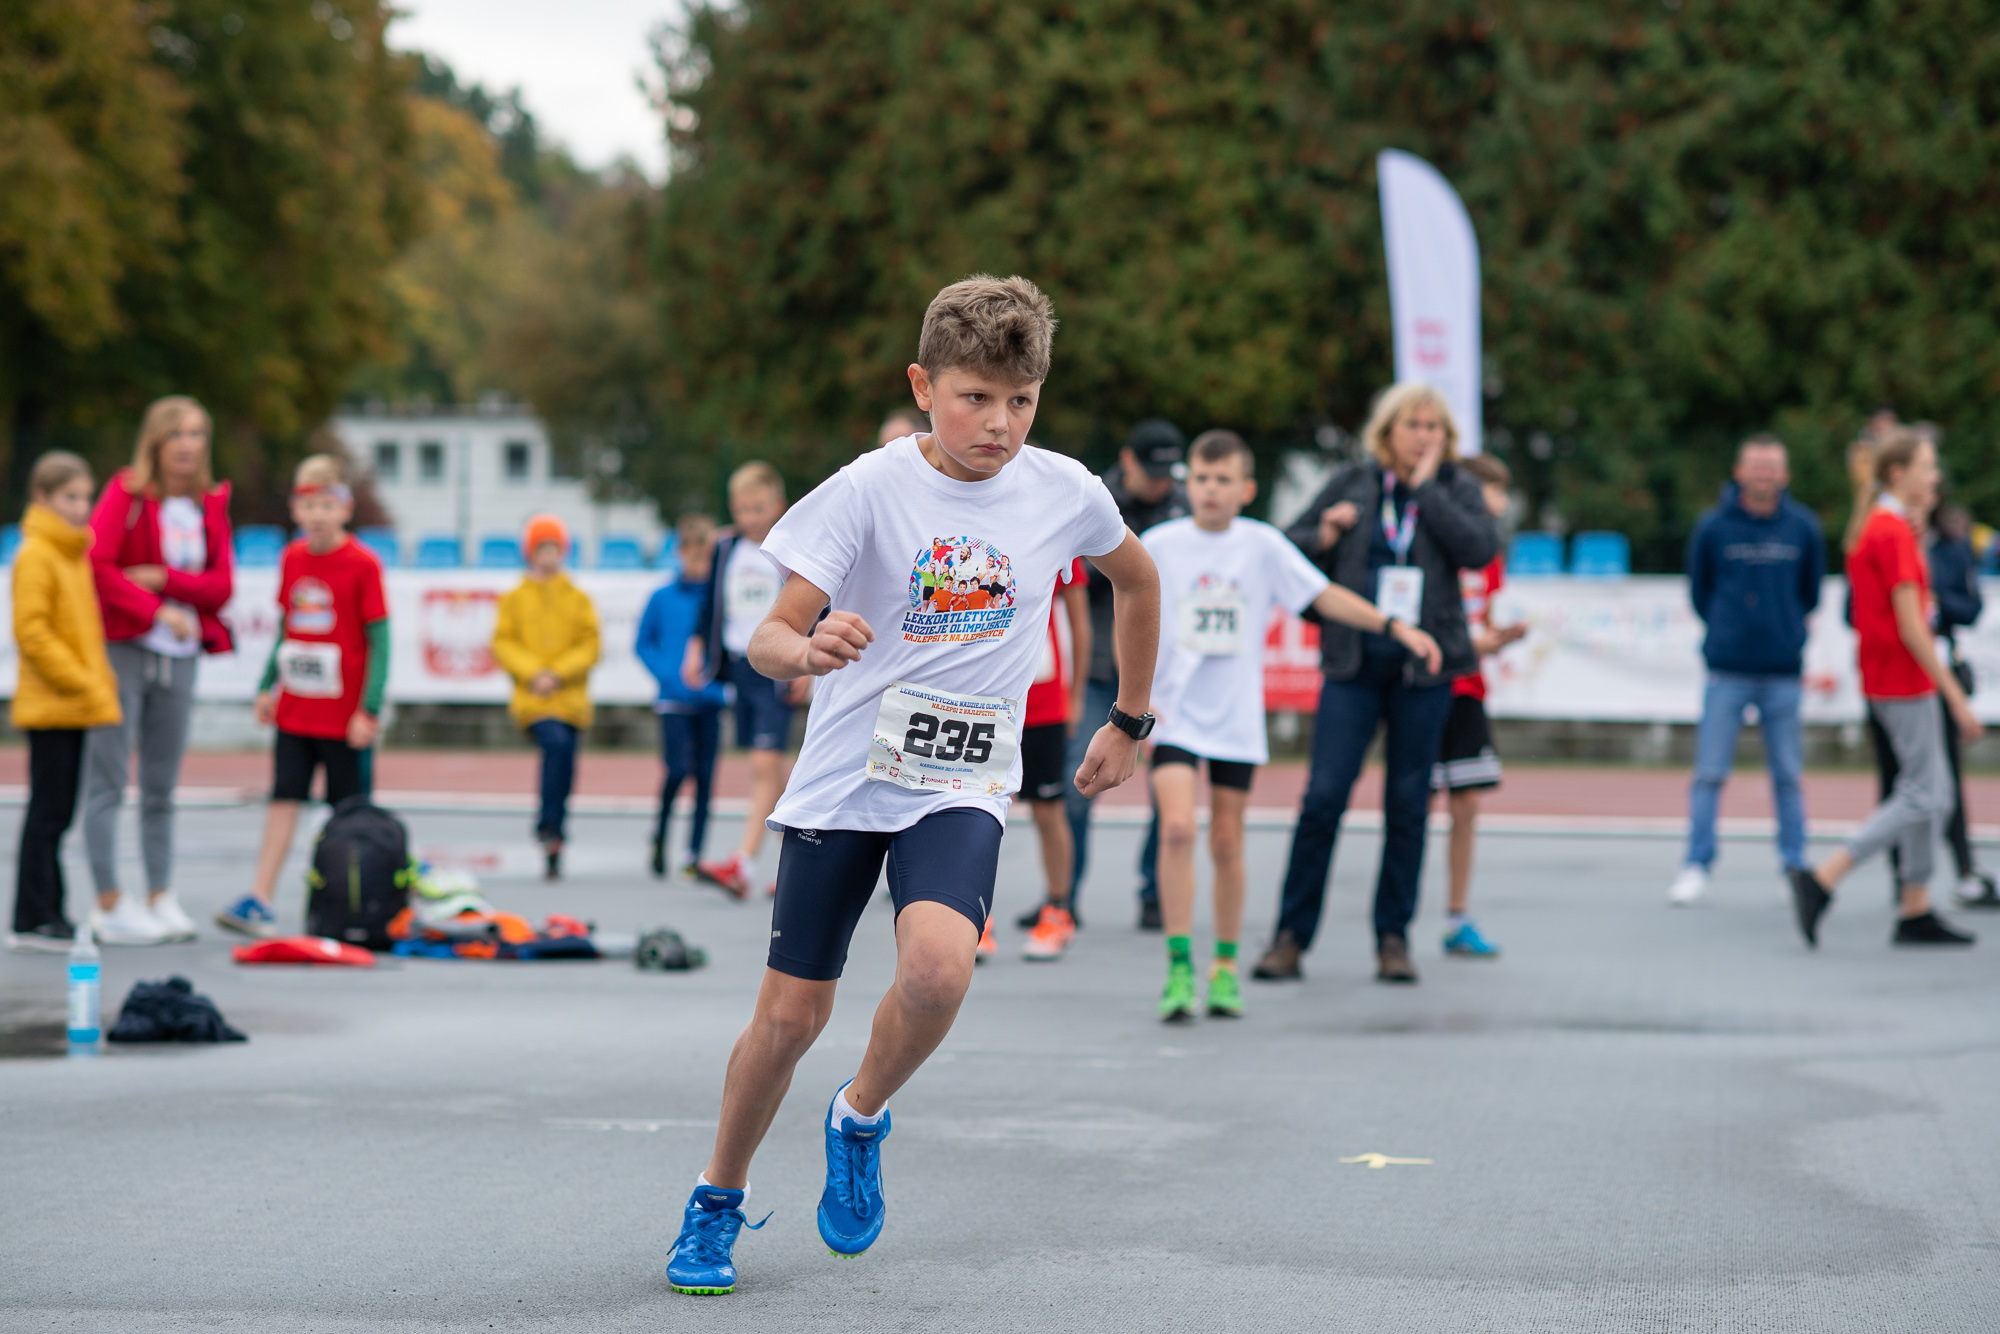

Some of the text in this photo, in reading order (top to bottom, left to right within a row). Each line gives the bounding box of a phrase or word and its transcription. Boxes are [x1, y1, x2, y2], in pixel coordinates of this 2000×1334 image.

[904, 607, 1017, 625] LEKKOATLETYCZNE
[901, 619, 1012, 635] NADZIEJE OLIMPIJSKIE
[903, 629, 1005, 643] NAJLEPSI Z NAJLEPSZYCH
[900, 687, 958, 706] LEKKOATLETYCZNE
[931, 703, 958, 714] NAJLEPSI
[903, 712, 996, 764] 235
